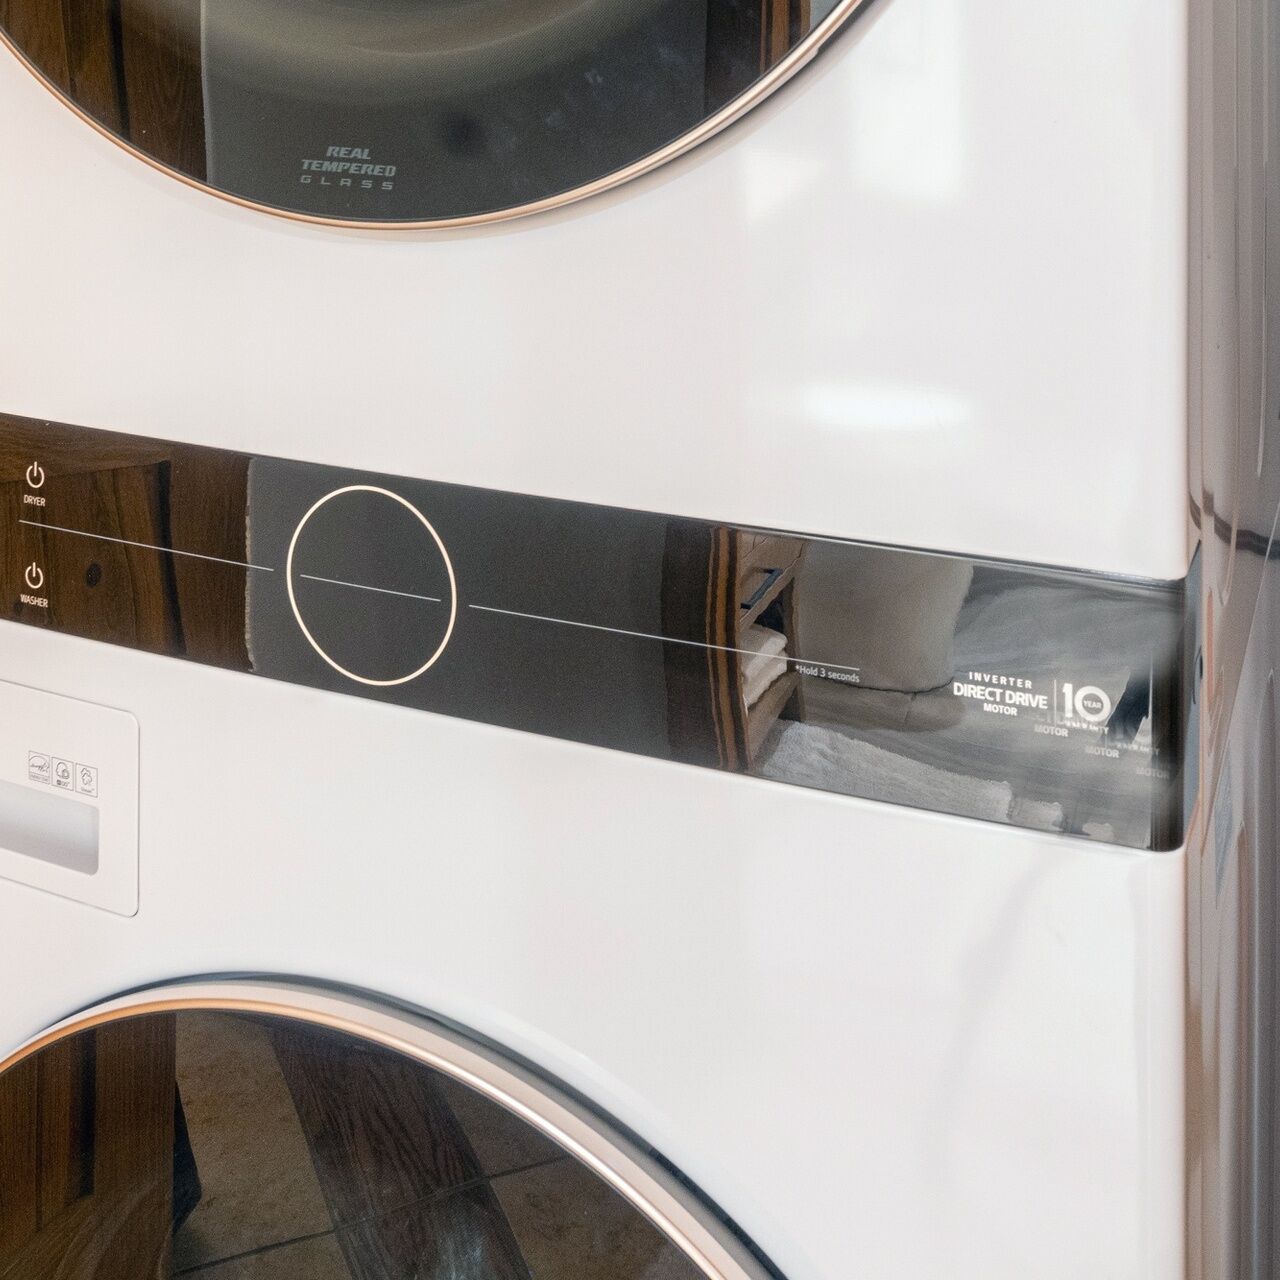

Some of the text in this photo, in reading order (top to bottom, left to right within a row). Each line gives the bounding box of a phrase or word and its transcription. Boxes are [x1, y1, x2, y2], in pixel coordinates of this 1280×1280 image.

[326, 146, 371, 160] REAL
[302, 159, 396, 177] TEMPERED
[300, 175, 394, 190] GLASS
[23, 494, 46, 507] DRYER
[20, 594, 49, 608] WASHER
[820, 668, 826, 677] 3
[827, 671, 860, 683] seconds
[969, 671, 1033, 689] INVERTER
[953, 682, 1048, 710] DIRECT DRIVE
[1062, 682, 1112, 722] 10
[1082, 698, 1102, 709] YEAR
[983, 702, 1018, 716] MOTOR
